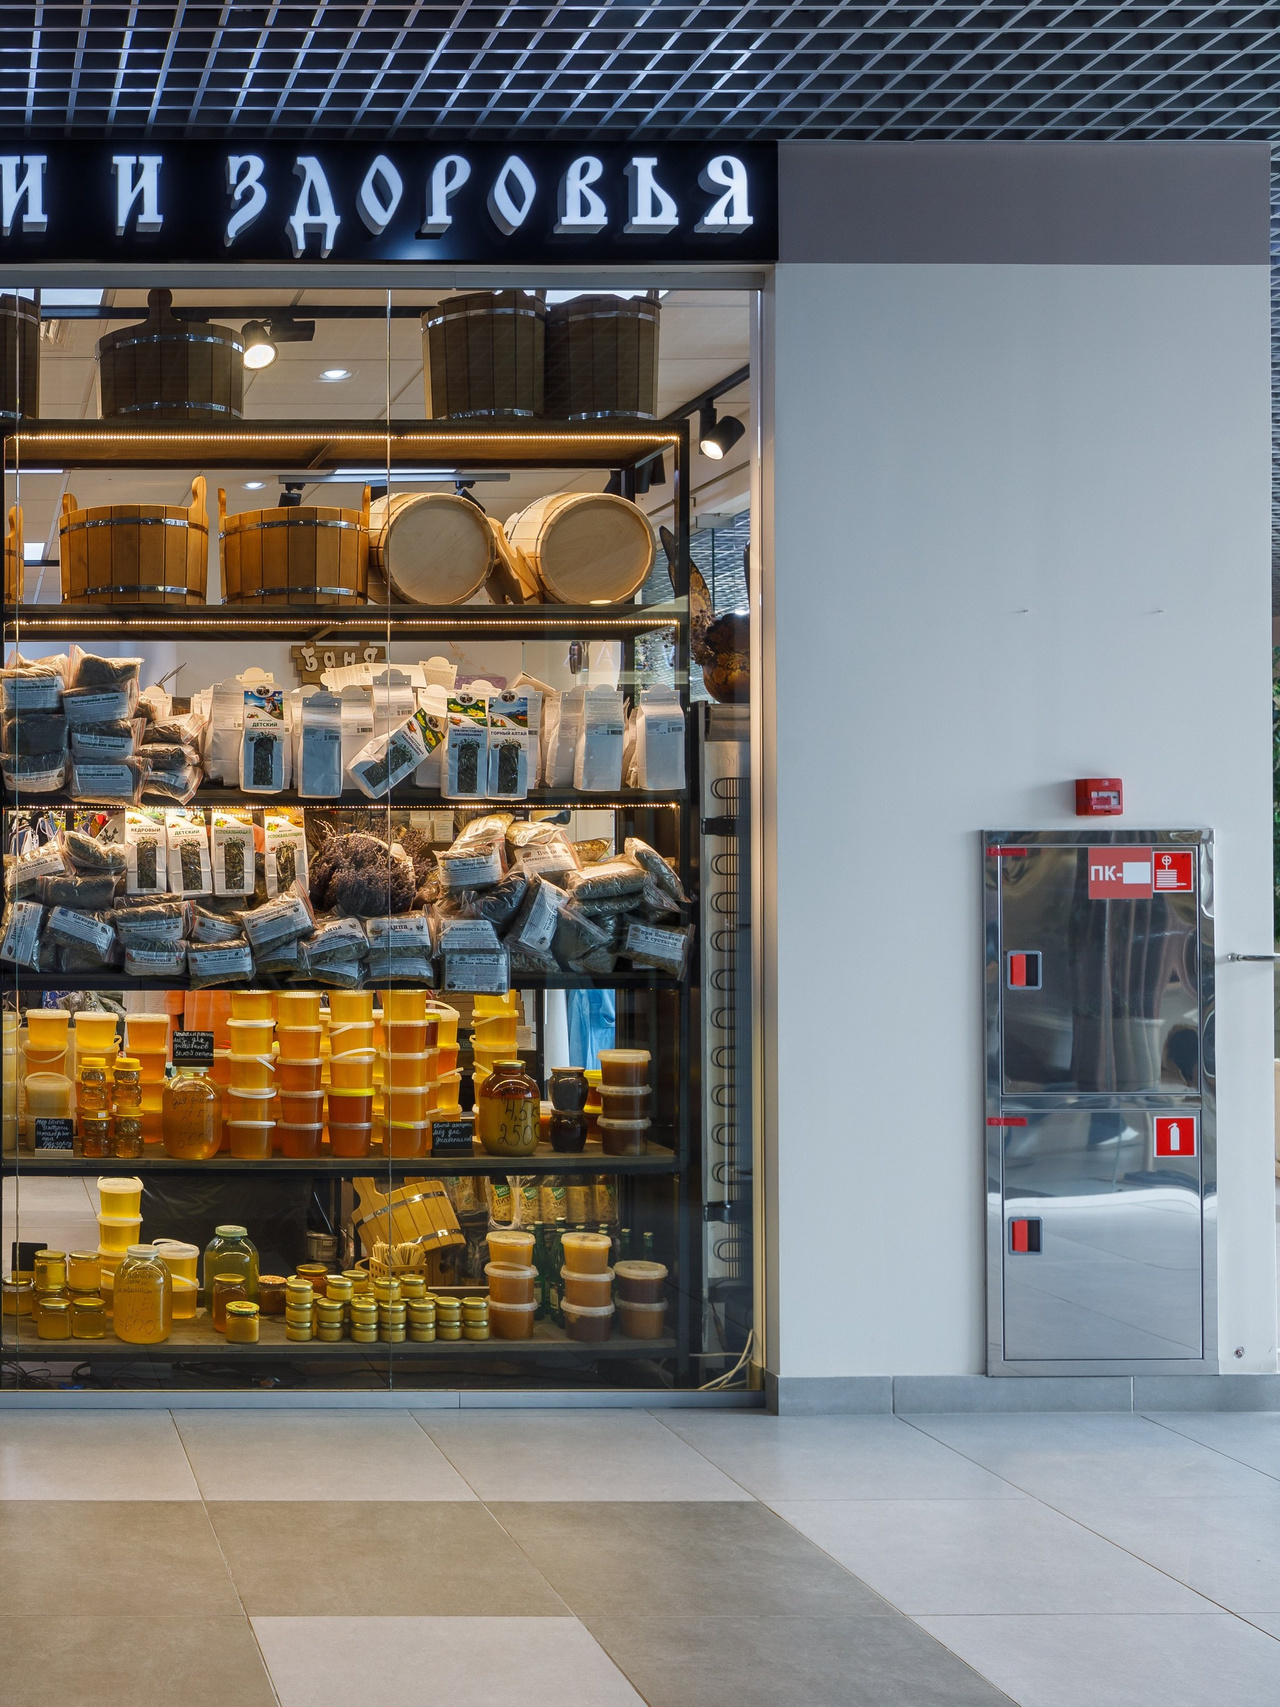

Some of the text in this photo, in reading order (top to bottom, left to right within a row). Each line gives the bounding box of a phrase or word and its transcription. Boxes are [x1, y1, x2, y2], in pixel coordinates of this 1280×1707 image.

[111, 155, 163, 235] И
[223, 154, 753, 257] ЗДОРОВЬЯ
[1091, 865, 1123, 881] ПК-
